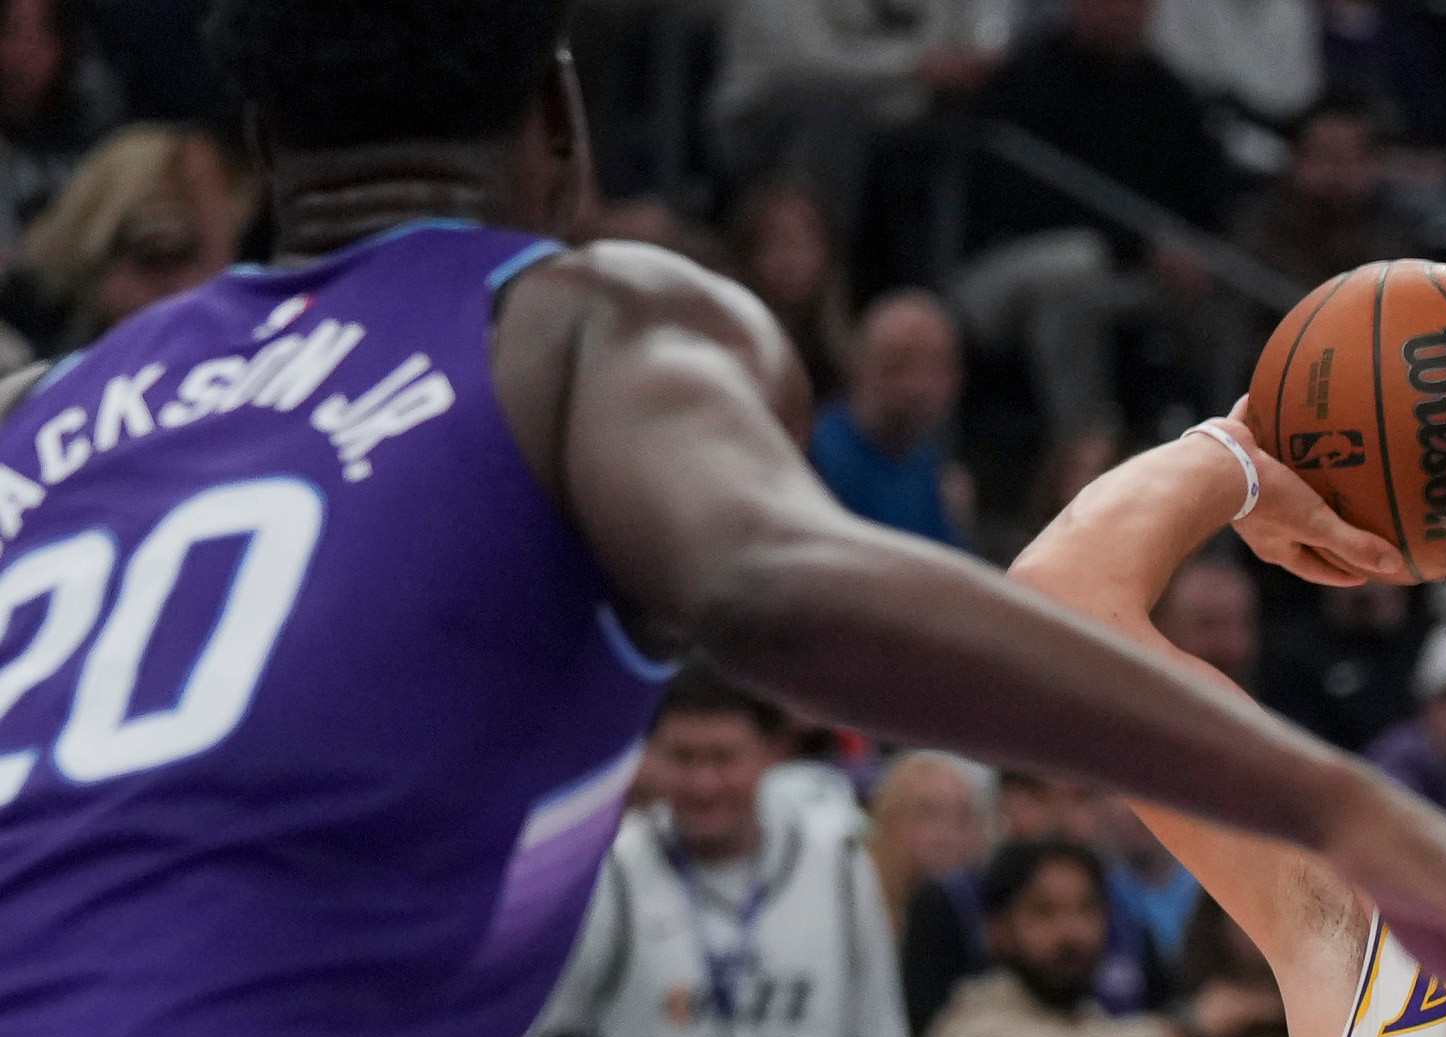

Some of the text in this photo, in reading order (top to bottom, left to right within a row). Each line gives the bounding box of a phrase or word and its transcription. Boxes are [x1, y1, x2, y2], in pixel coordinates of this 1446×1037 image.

[0, 317, 456, 558] ACKSON JR.
[0, 473, 325, 808] 20
